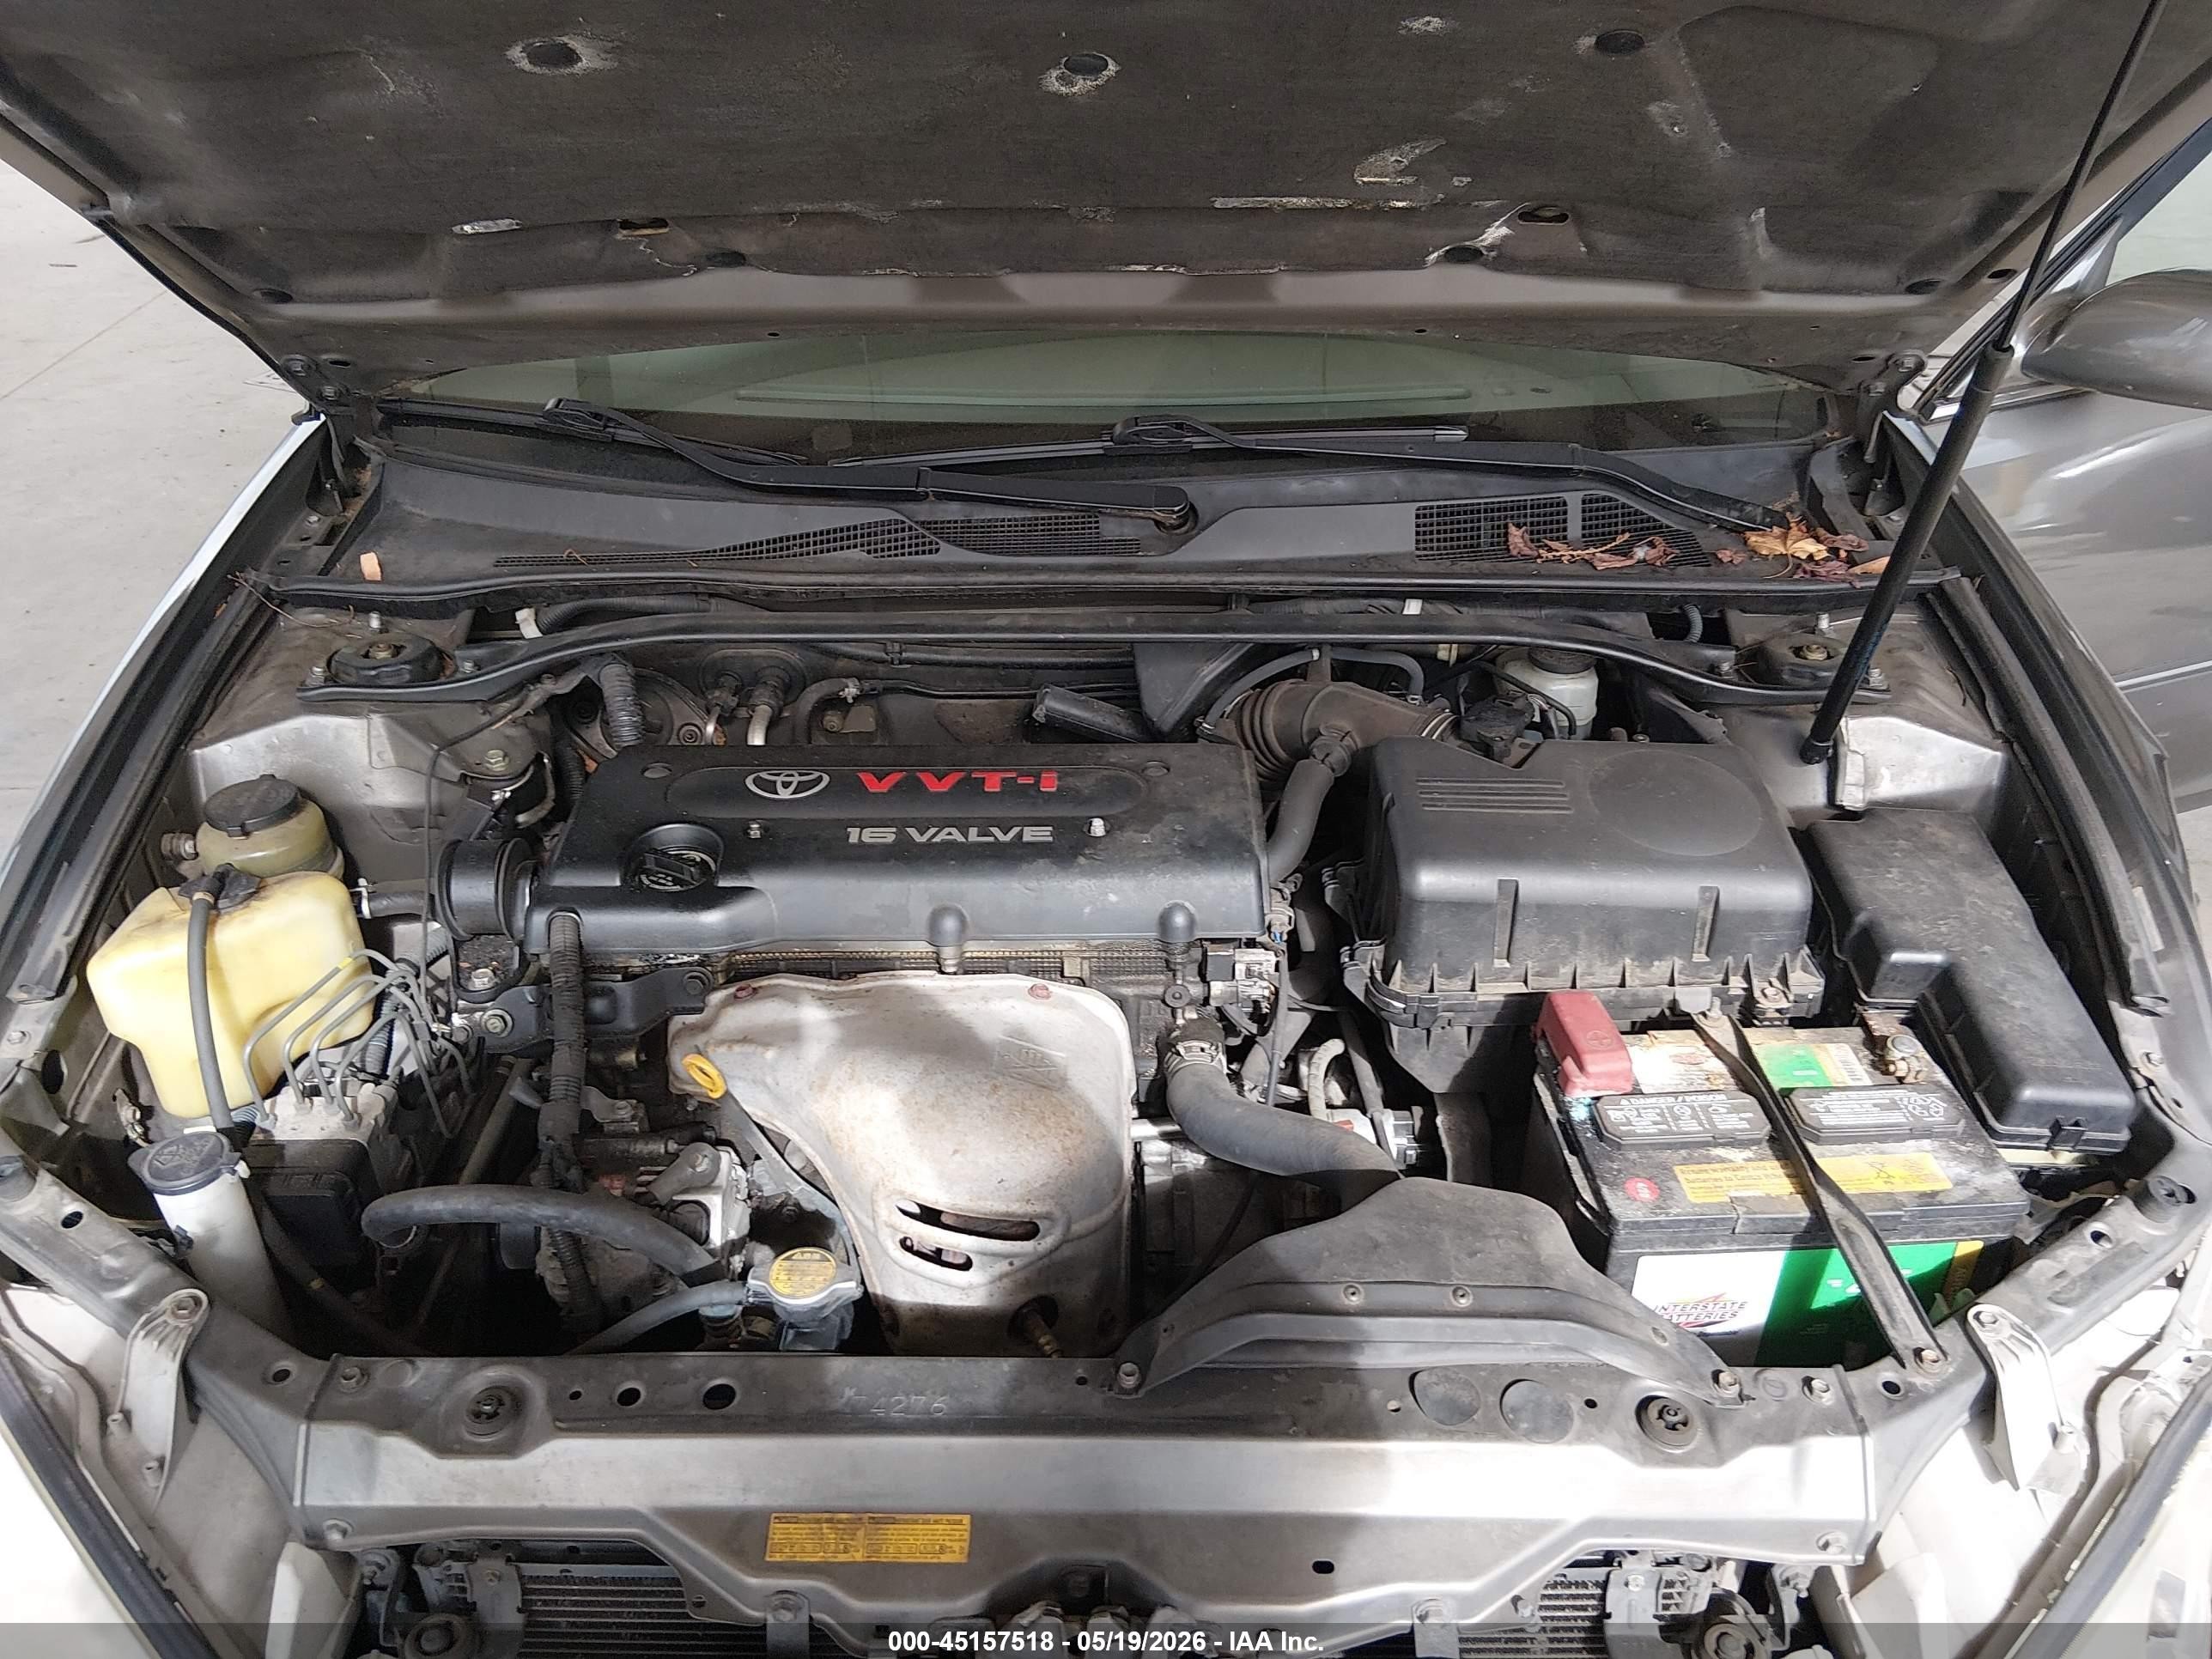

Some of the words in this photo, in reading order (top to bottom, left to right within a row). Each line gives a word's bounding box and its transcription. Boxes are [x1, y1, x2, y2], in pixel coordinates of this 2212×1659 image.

[847, 826, 896, 843] 16
[905, 826, 1053, 843] VALVE
[1654, 1301, 1747, 1312] INTERSTATE
[1662, 1311, 1738, 1321] ATTERIES
